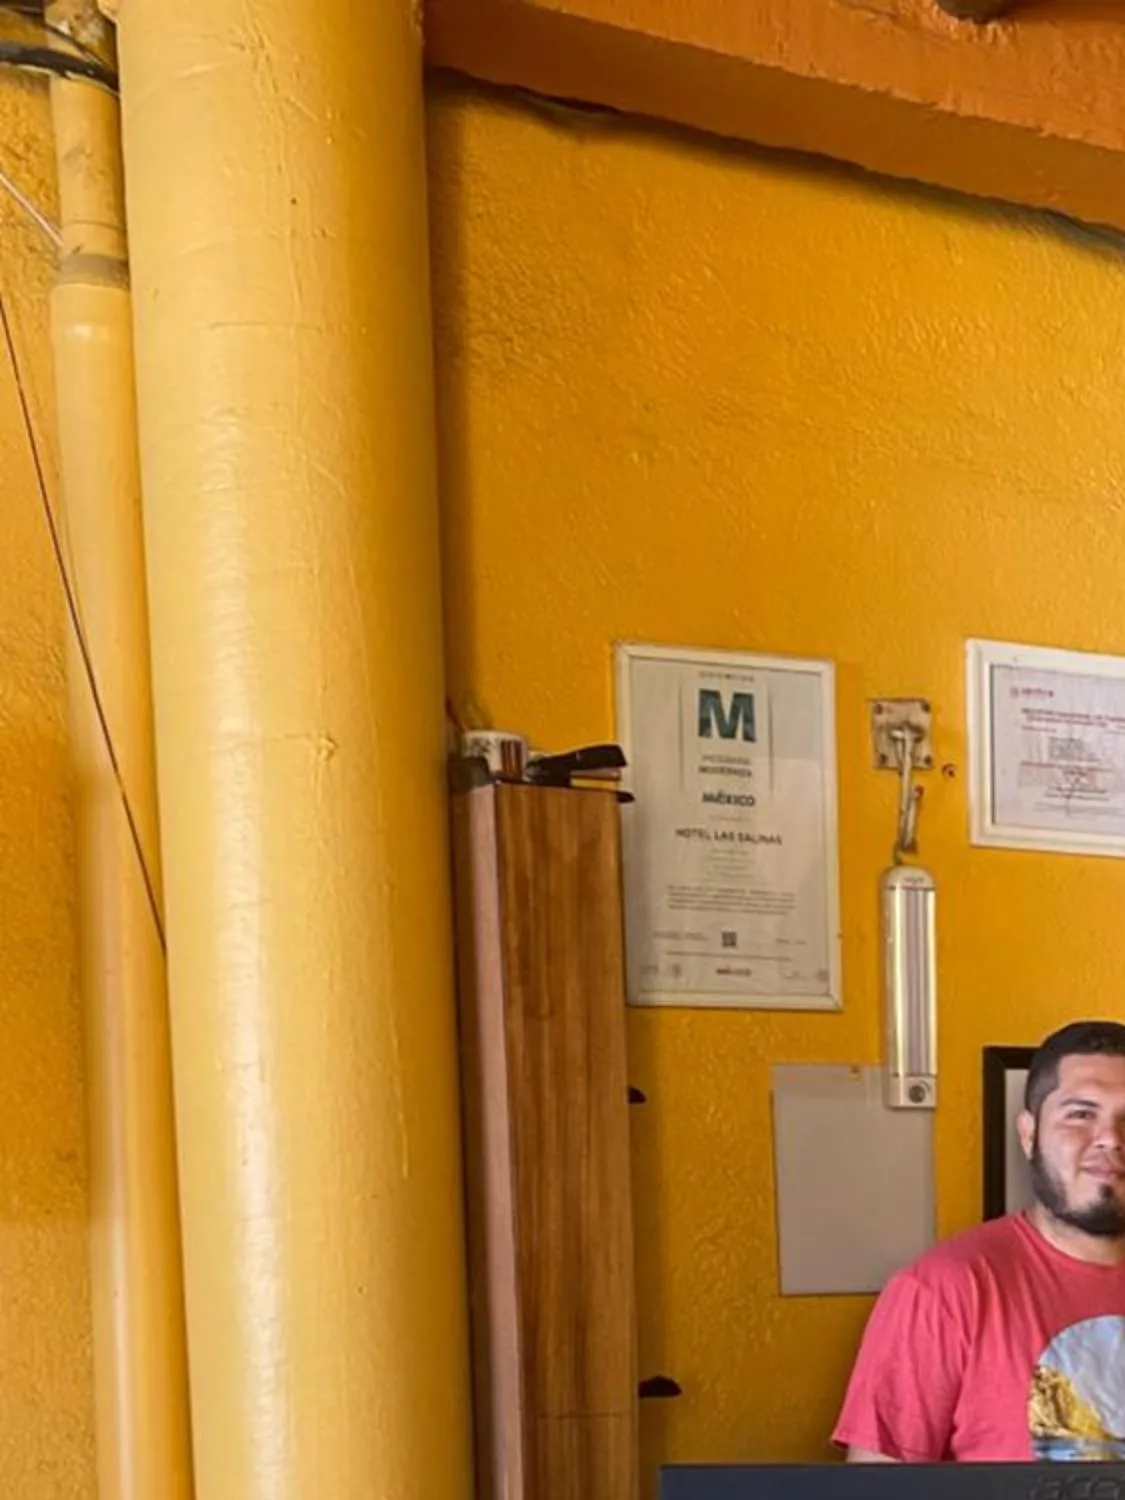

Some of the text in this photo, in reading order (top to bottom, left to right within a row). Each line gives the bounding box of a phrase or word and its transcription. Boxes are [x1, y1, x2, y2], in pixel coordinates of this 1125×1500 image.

[698, 688, 756, 743] M
[675, 827, 711, 841] HOTEL
[713, 830, 734, 843] LAS
